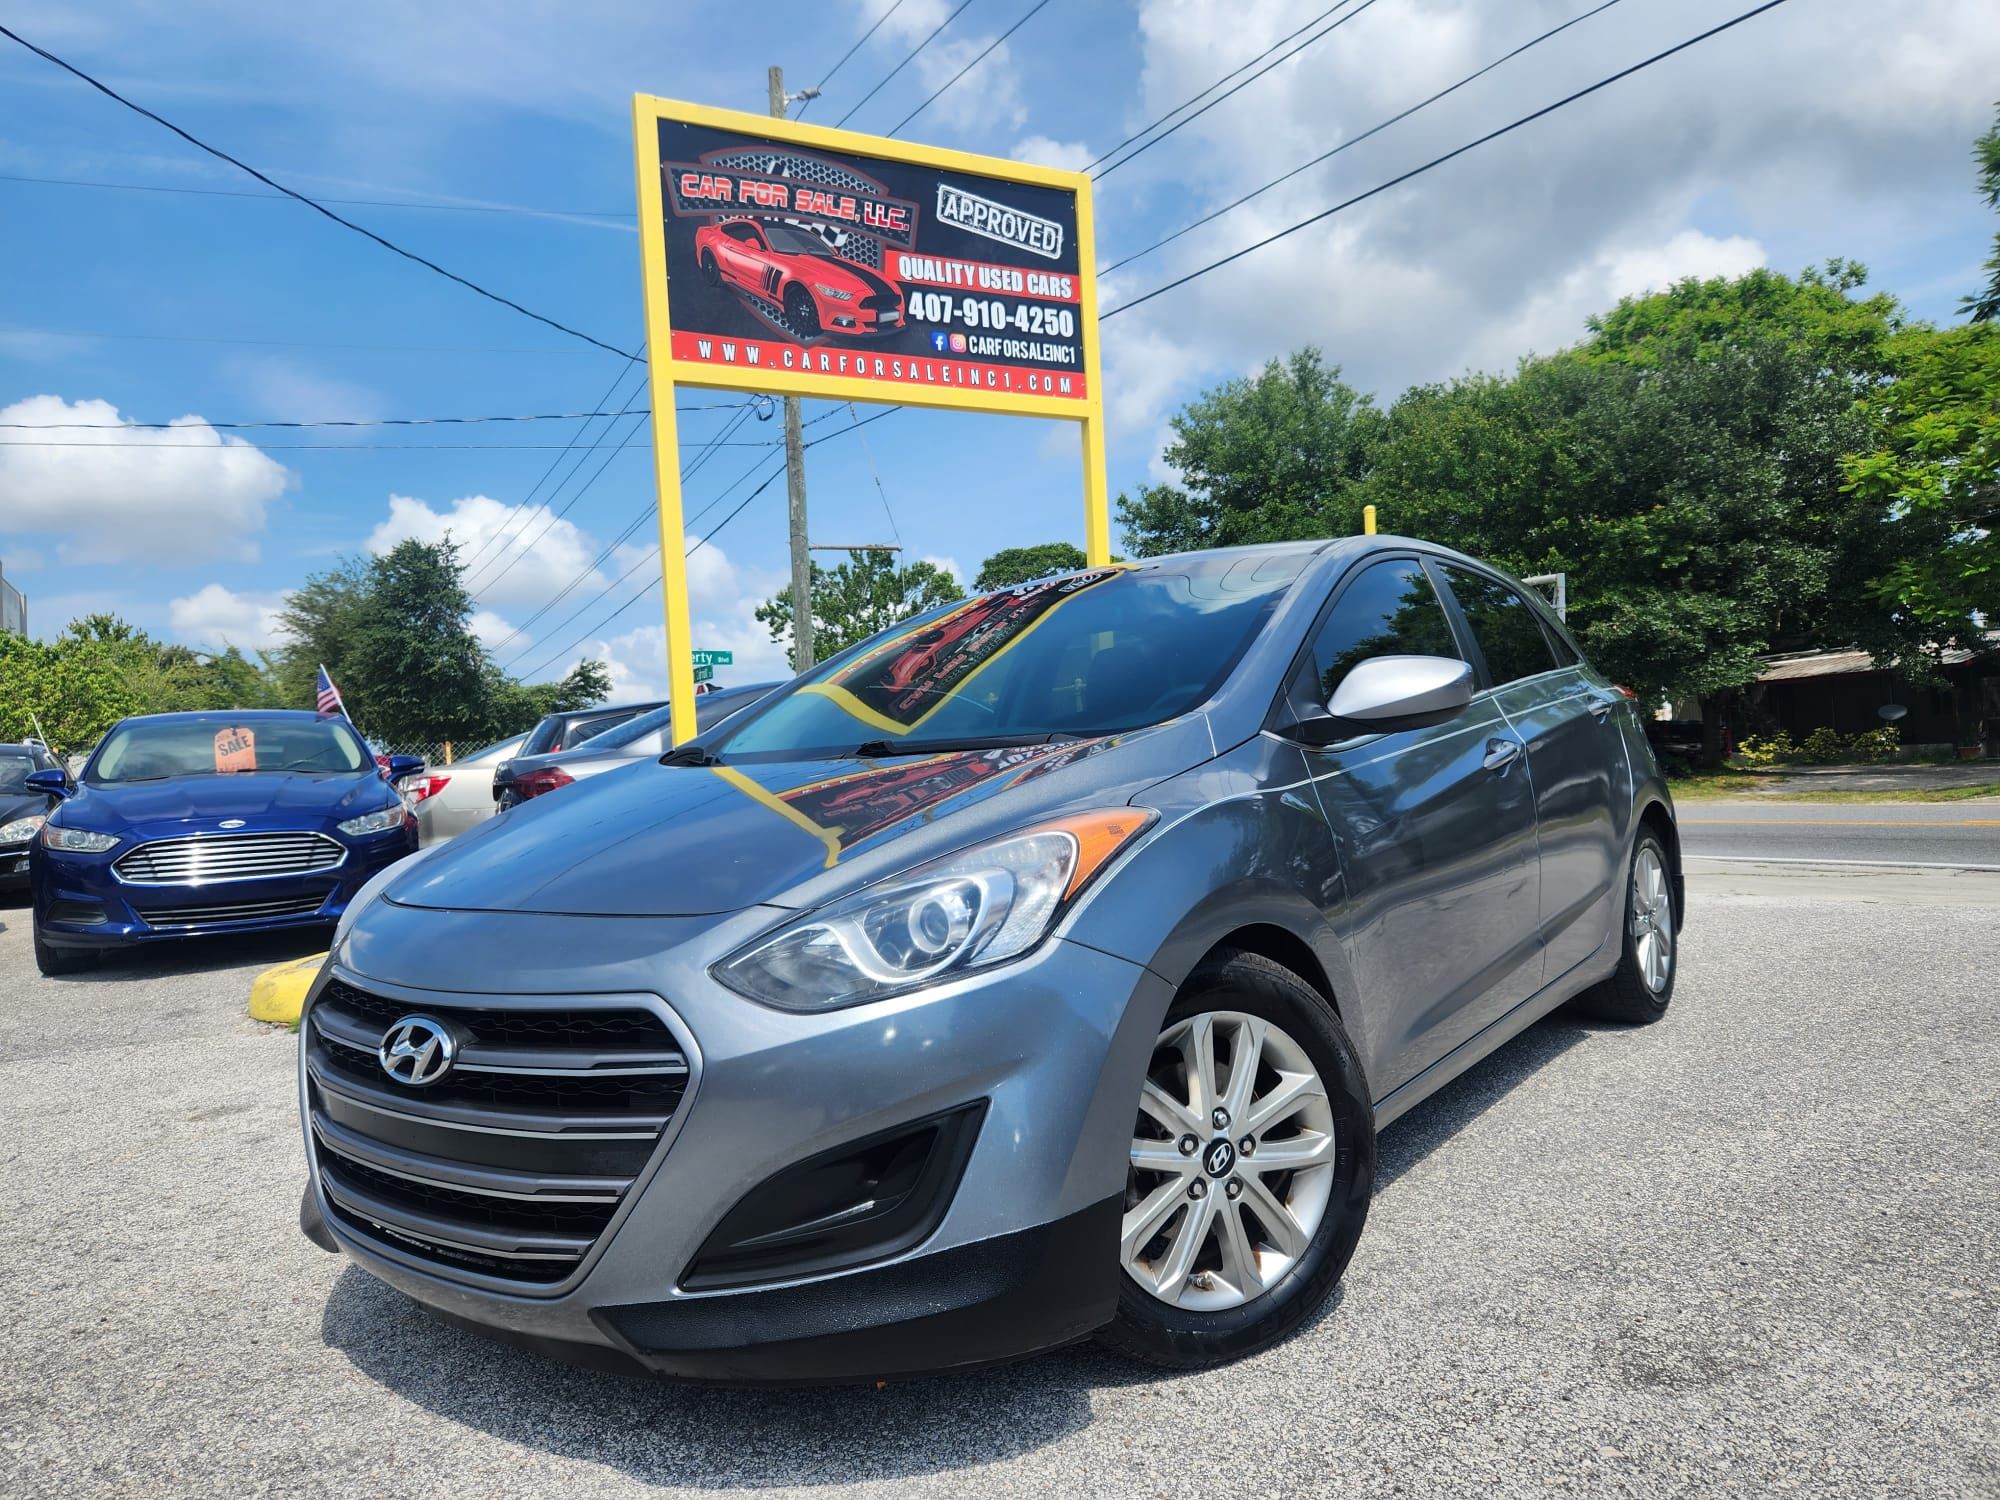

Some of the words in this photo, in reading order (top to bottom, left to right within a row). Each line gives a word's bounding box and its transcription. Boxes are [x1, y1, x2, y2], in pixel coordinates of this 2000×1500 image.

[681, 173, 732, 200] CAR
[739, 179, 788, 207] FOR
[795, 189, 861, 222] SALE,
[864, 201, 910, 232] LLC.
[944, 193, 1057, 251] APPROVED
[898, 255, 976, 287] QUALITY
[978, 266, 1023, 293] USED
[1026, 273, 1072, 299] CARS
[908, 291, 1075, 338] 407-910-4250
[968, 335, 1076, 364] CARFORSALEINC1
[218, 735, 251, 756] SALE
